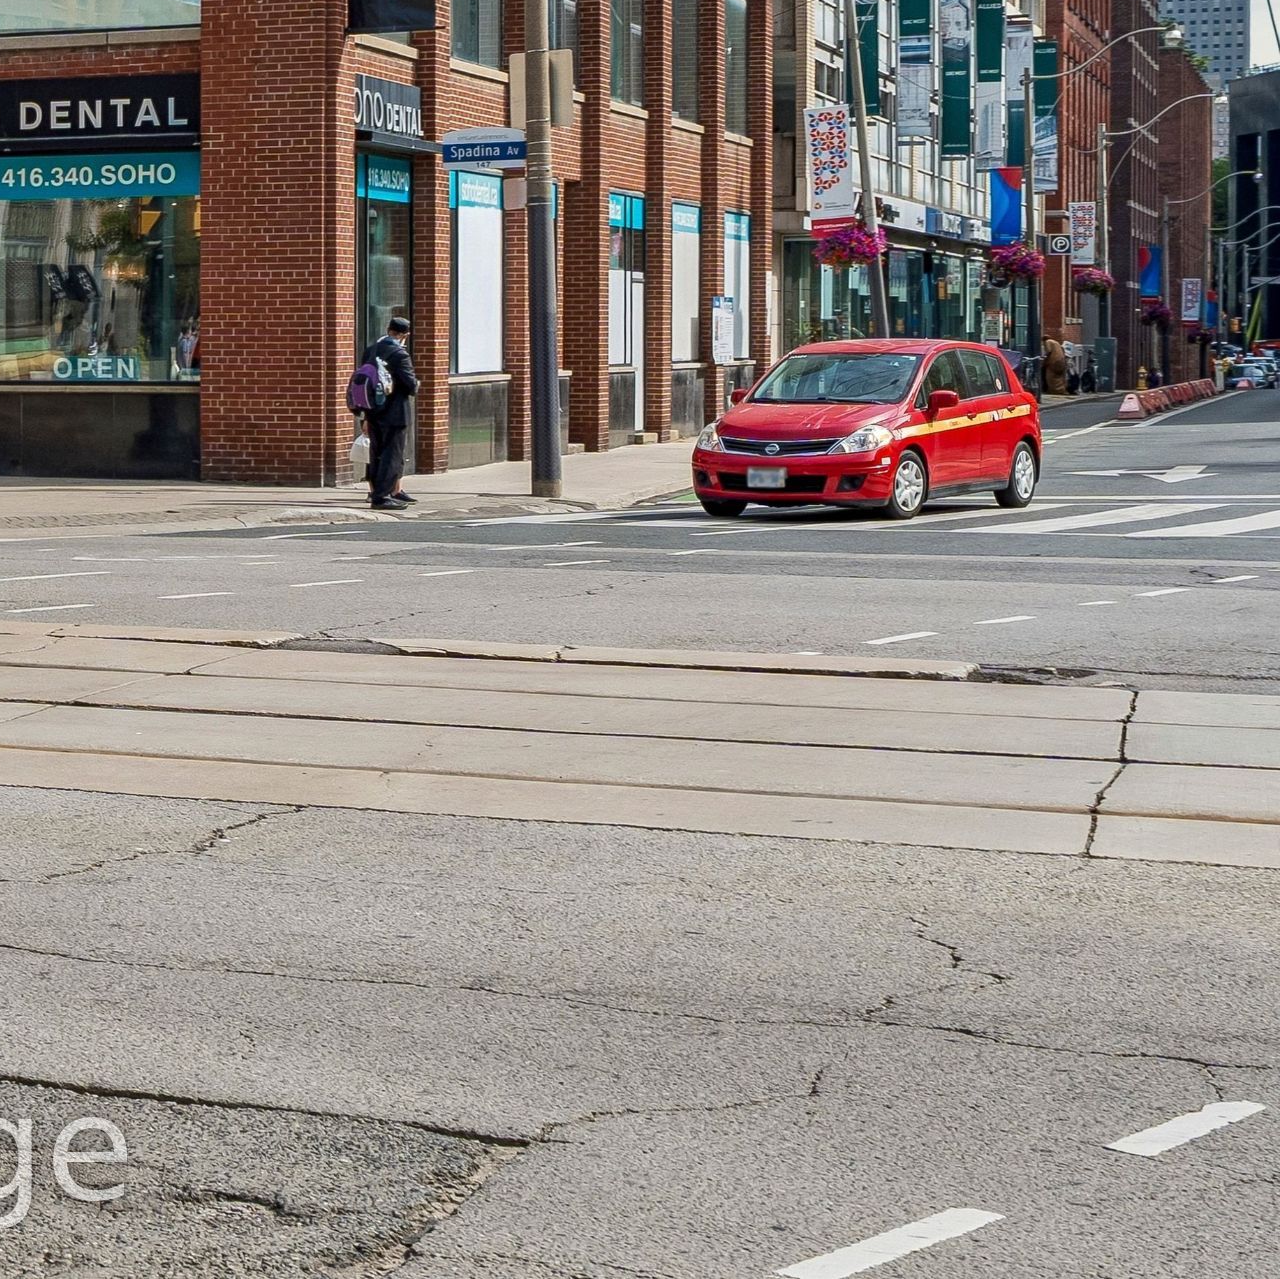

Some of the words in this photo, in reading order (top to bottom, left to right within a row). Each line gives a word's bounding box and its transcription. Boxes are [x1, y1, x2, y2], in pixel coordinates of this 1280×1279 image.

[19, 97, 188, 131] DENTAL
[353, 75, 384, 128] oho
[386, 102, 424, 137] DENTAL
[450, 145, 500, 160] Spadina
[506, 146, 519, 155] Av
[1, 164, 176, 188] 416.340.SOHO
[53, 357, 135, 379] OPEN
